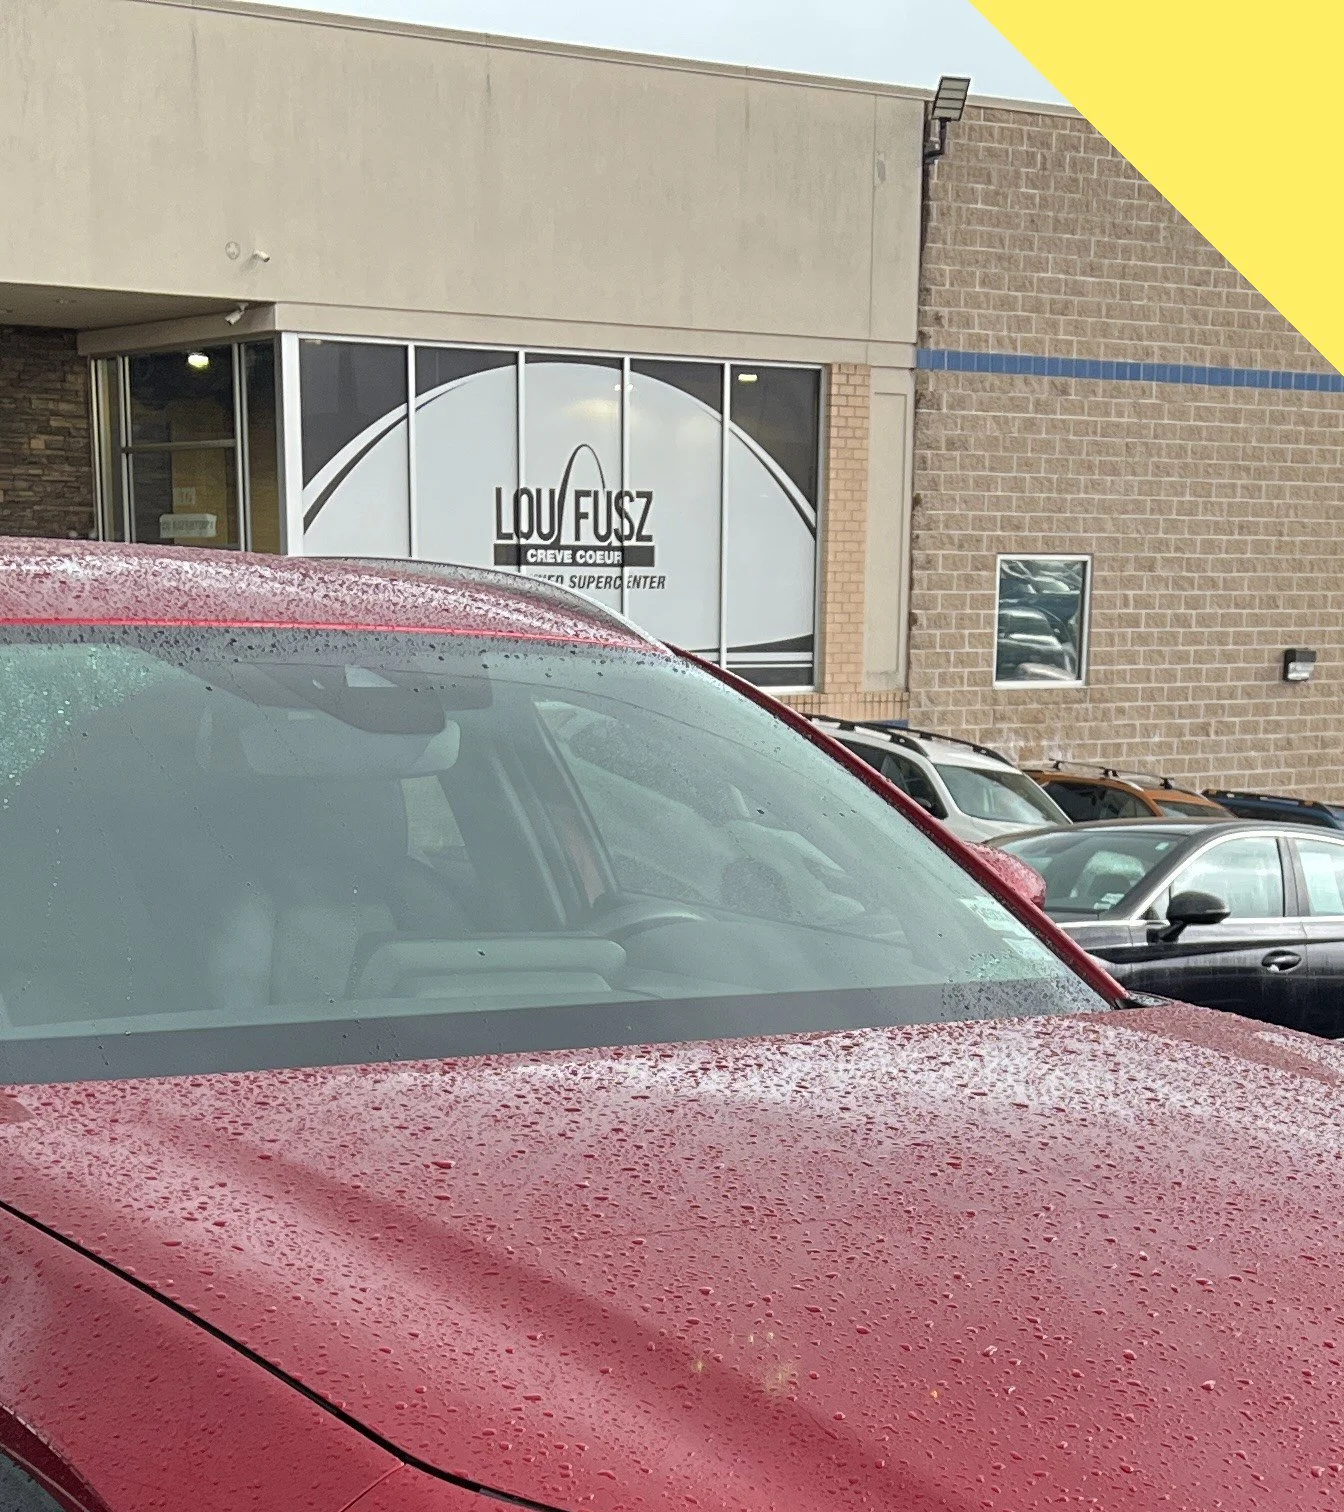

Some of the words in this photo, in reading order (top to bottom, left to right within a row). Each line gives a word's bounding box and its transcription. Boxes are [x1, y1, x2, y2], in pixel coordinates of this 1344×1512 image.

[495, 486, 556, 542] LOU
[574, 489, 654, 543] FUSZ
[526, 549, 573, 564] CREVE
[575, 550, 624, 565] COEUR
[568, 574, 666, 591] SUPERCENTER
